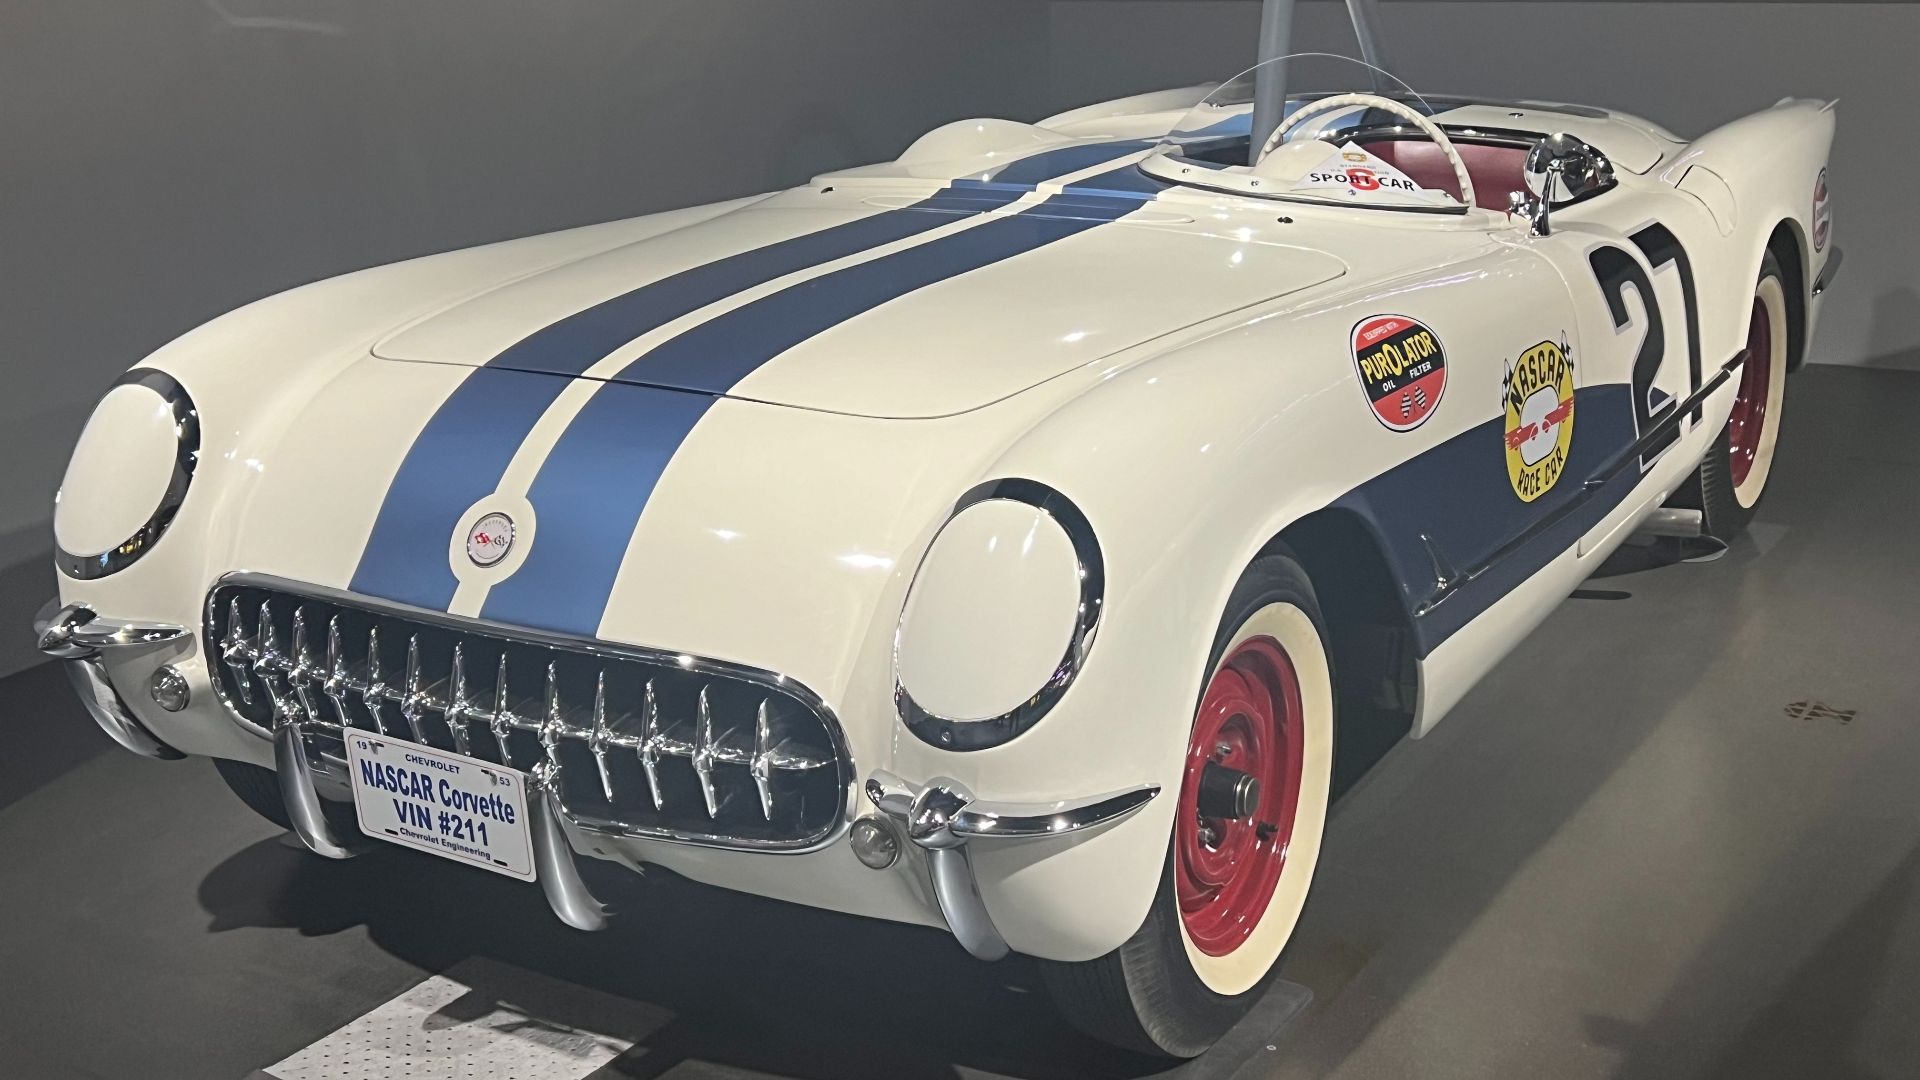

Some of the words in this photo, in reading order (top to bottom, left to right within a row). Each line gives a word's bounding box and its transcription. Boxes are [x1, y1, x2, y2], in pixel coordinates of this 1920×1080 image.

[1310, 172, 1371, 185] SPORT
[1377, 177, 1415, 192] CAR
[1360, 331, 1437, 384] PUROLATOR
[1382, 379, 1396, 392] OIL
[1409, 360, 1432, 379] FILTER
[1510, 348, 1565, 416] NASCAR
[1517, 467, 1541, 497] RACE
[1545, 447, 1563, 486] CAR
[356, 740, 368, 751] 19
[405, 753, 461, 775] CHEVROLET
[360, 758, 436, 804] NASCAR
[438, 778, 516, 825] Corvette
[498, 776, 511, 787] 53
[393, 798, 433, 831] VIN
[437, 810, 489, 847] #211
[399, 827, 439, 845] Chevrolet
[441, 838, 491, 861] Engineering
